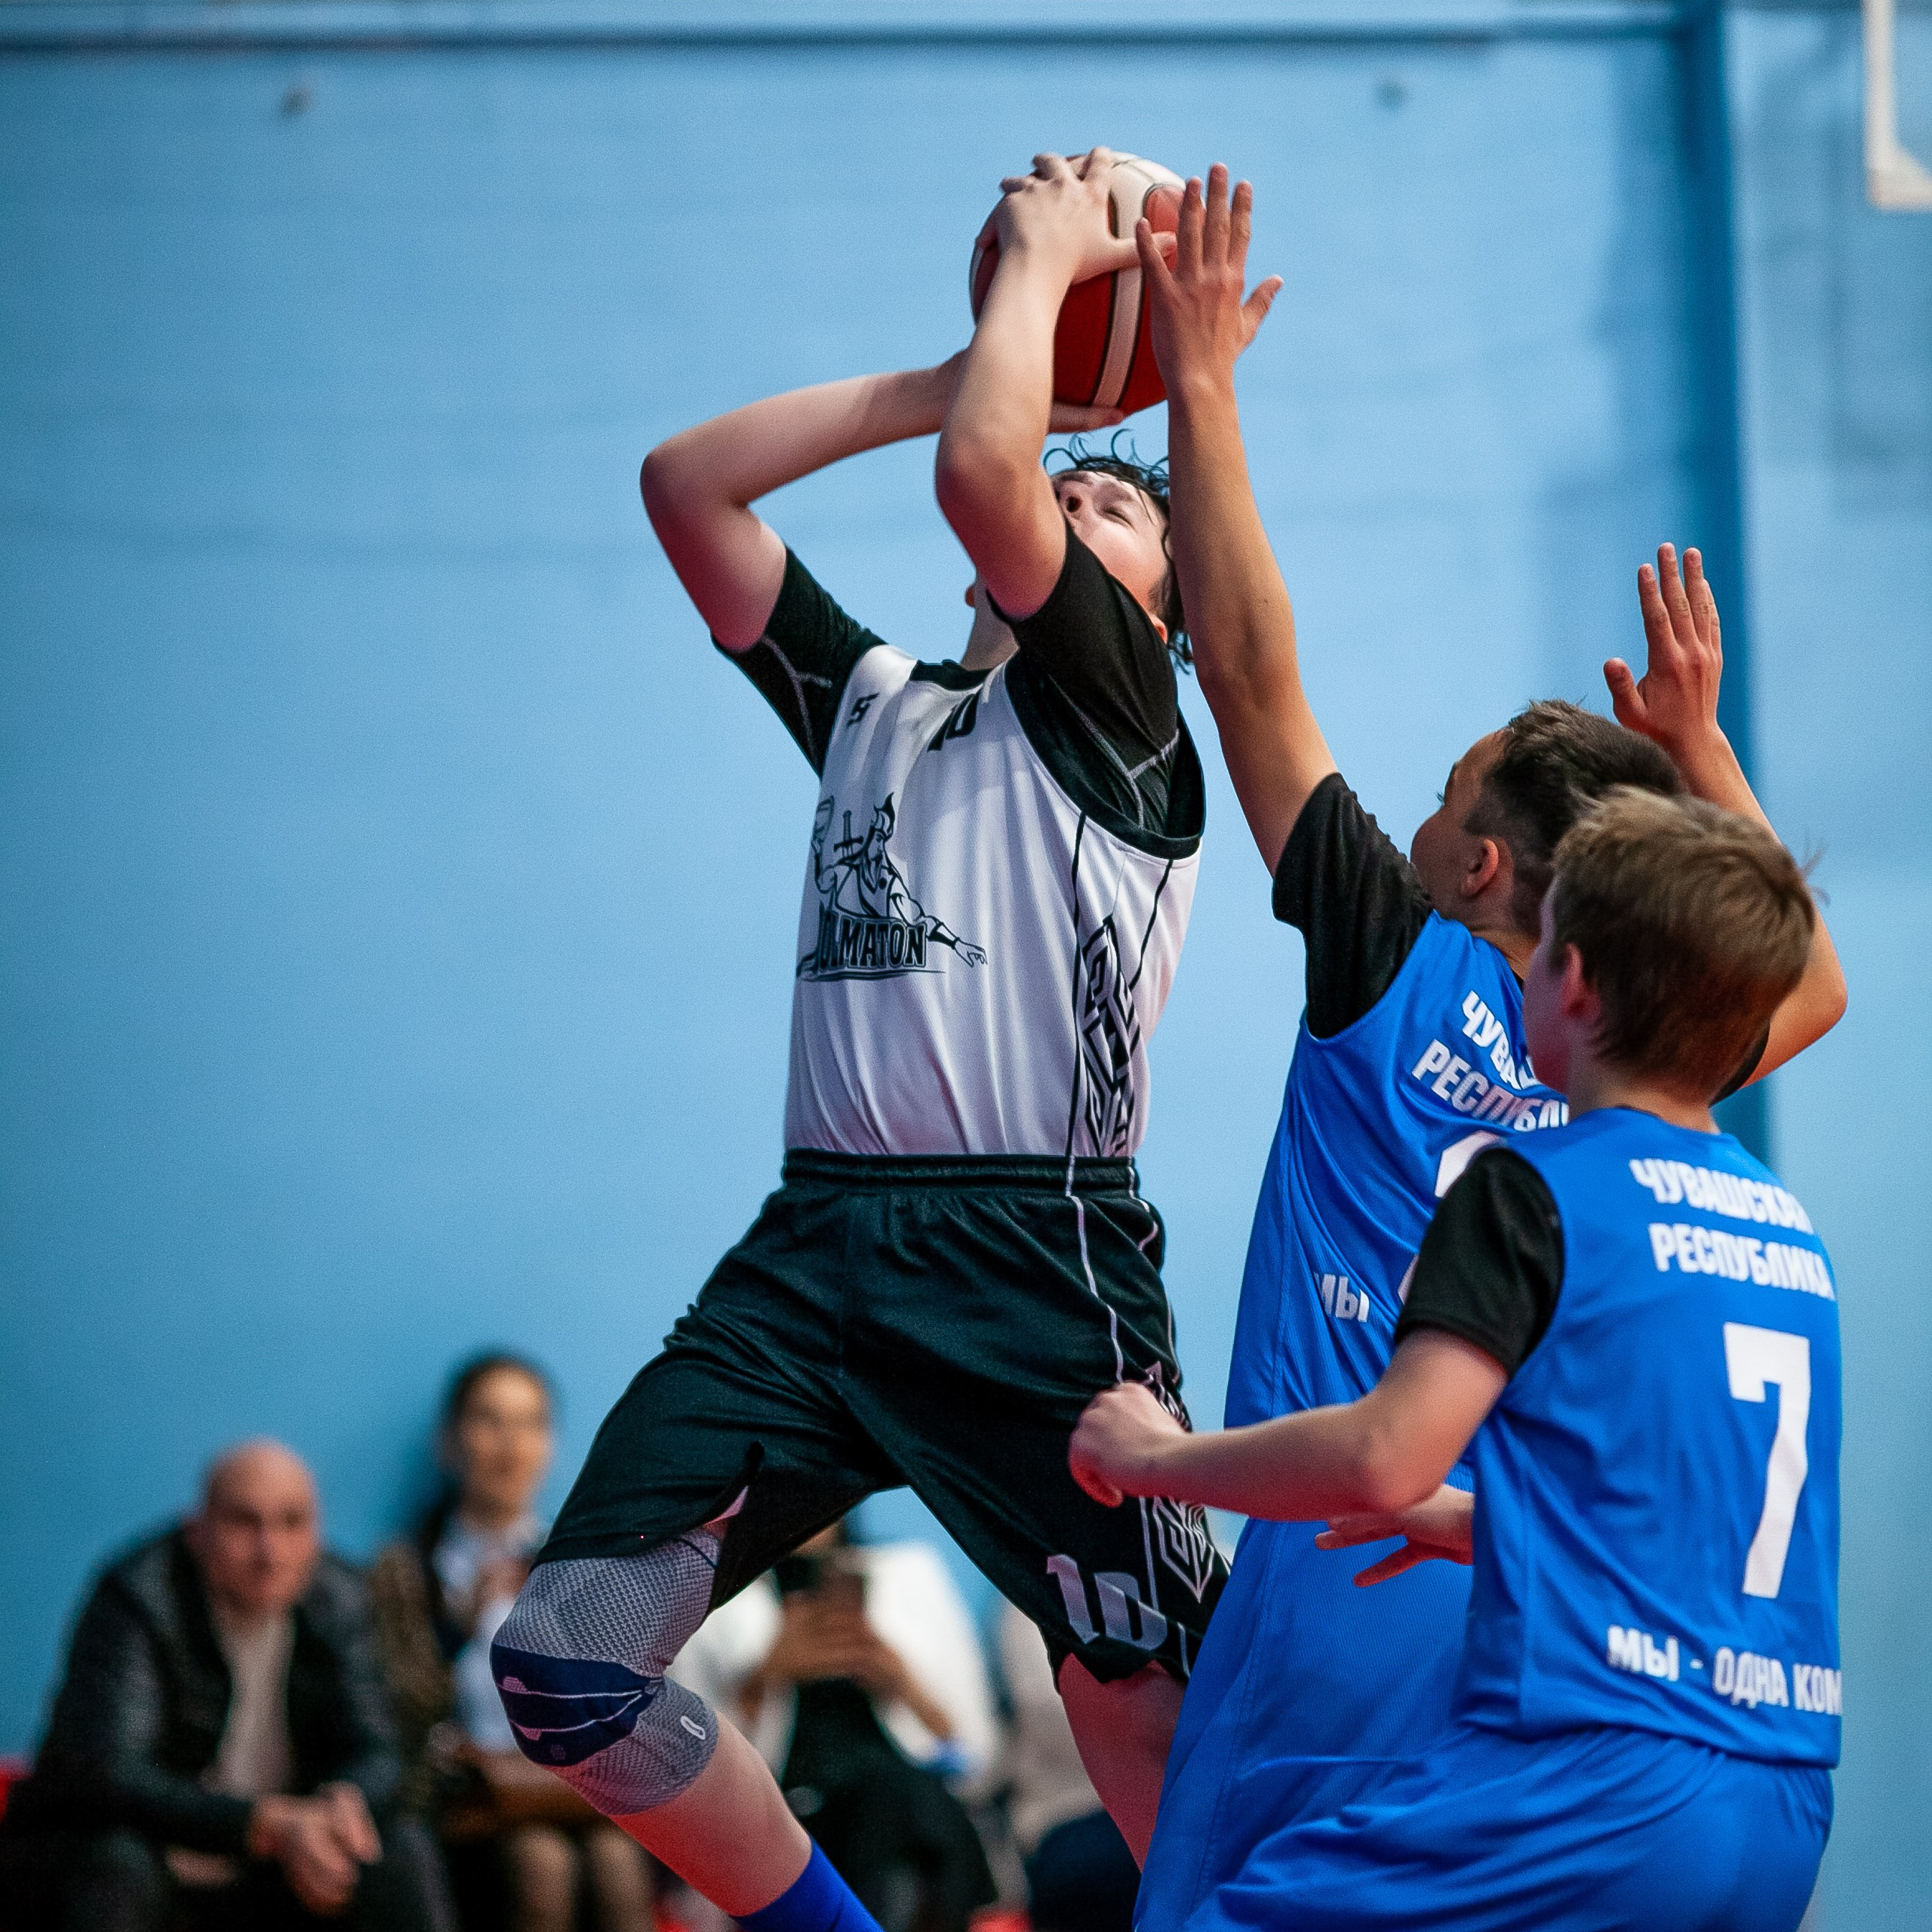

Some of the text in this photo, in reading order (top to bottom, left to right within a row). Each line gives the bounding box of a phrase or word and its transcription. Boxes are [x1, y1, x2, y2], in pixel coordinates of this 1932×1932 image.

[1723, 1321, 1810, 1599] 7
[1047, 1554, 1168, 1644] 10
[1607, 1625, 1679, 1682] МЫ
[1712, 1647, 1789, 1709] ОДНА
